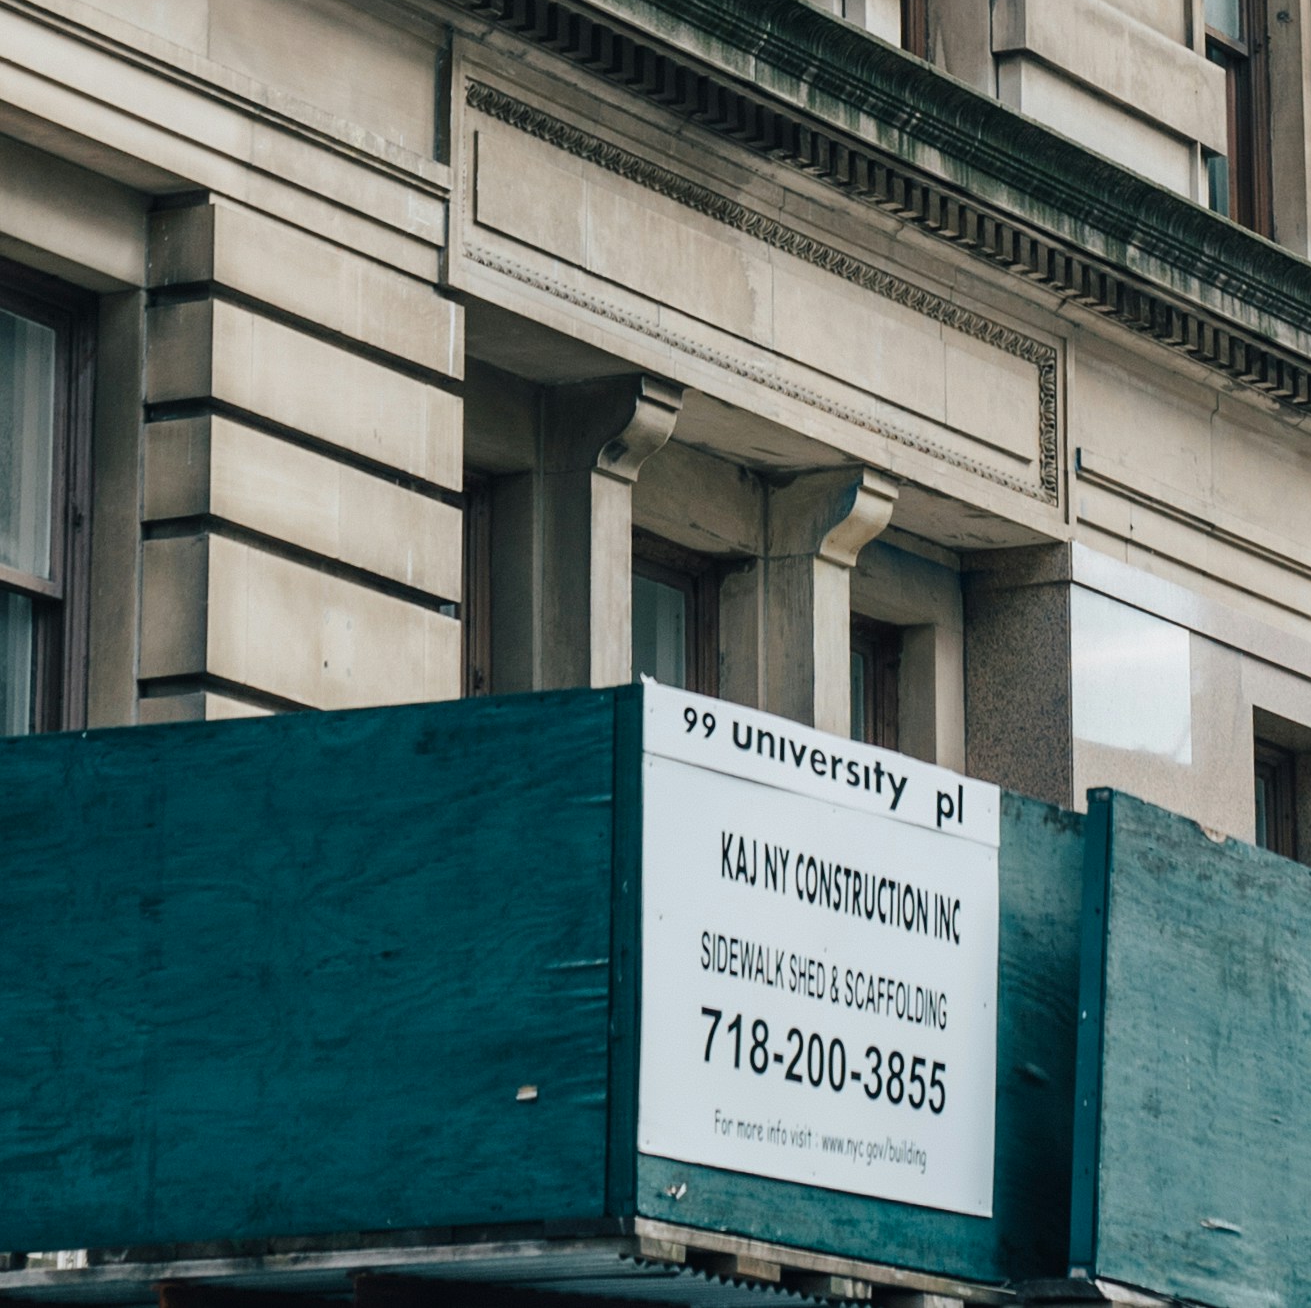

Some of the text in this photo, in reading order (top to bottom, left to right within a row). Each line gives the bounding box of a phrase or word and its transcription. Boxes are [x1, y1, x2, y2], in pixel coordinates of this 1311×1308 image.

[683, 706, 964, 827] 99 university pl
[721, 831, 961, 947] KAJ NY CONSTRUCTION INC
[700, 931, 948, 1032] SIDEWALK SHED & SCAFFOLDING
[700, 1005, 947, 1117] 718-200-3855
[714, 1108, 734, 1136] For
[736, 1120, 764, 1143] more
[766, 1119, 787, 1146] info
[789, 1124, 812, 1149] visit
[821, 1135, 927, 1175] www.nycgov/building
